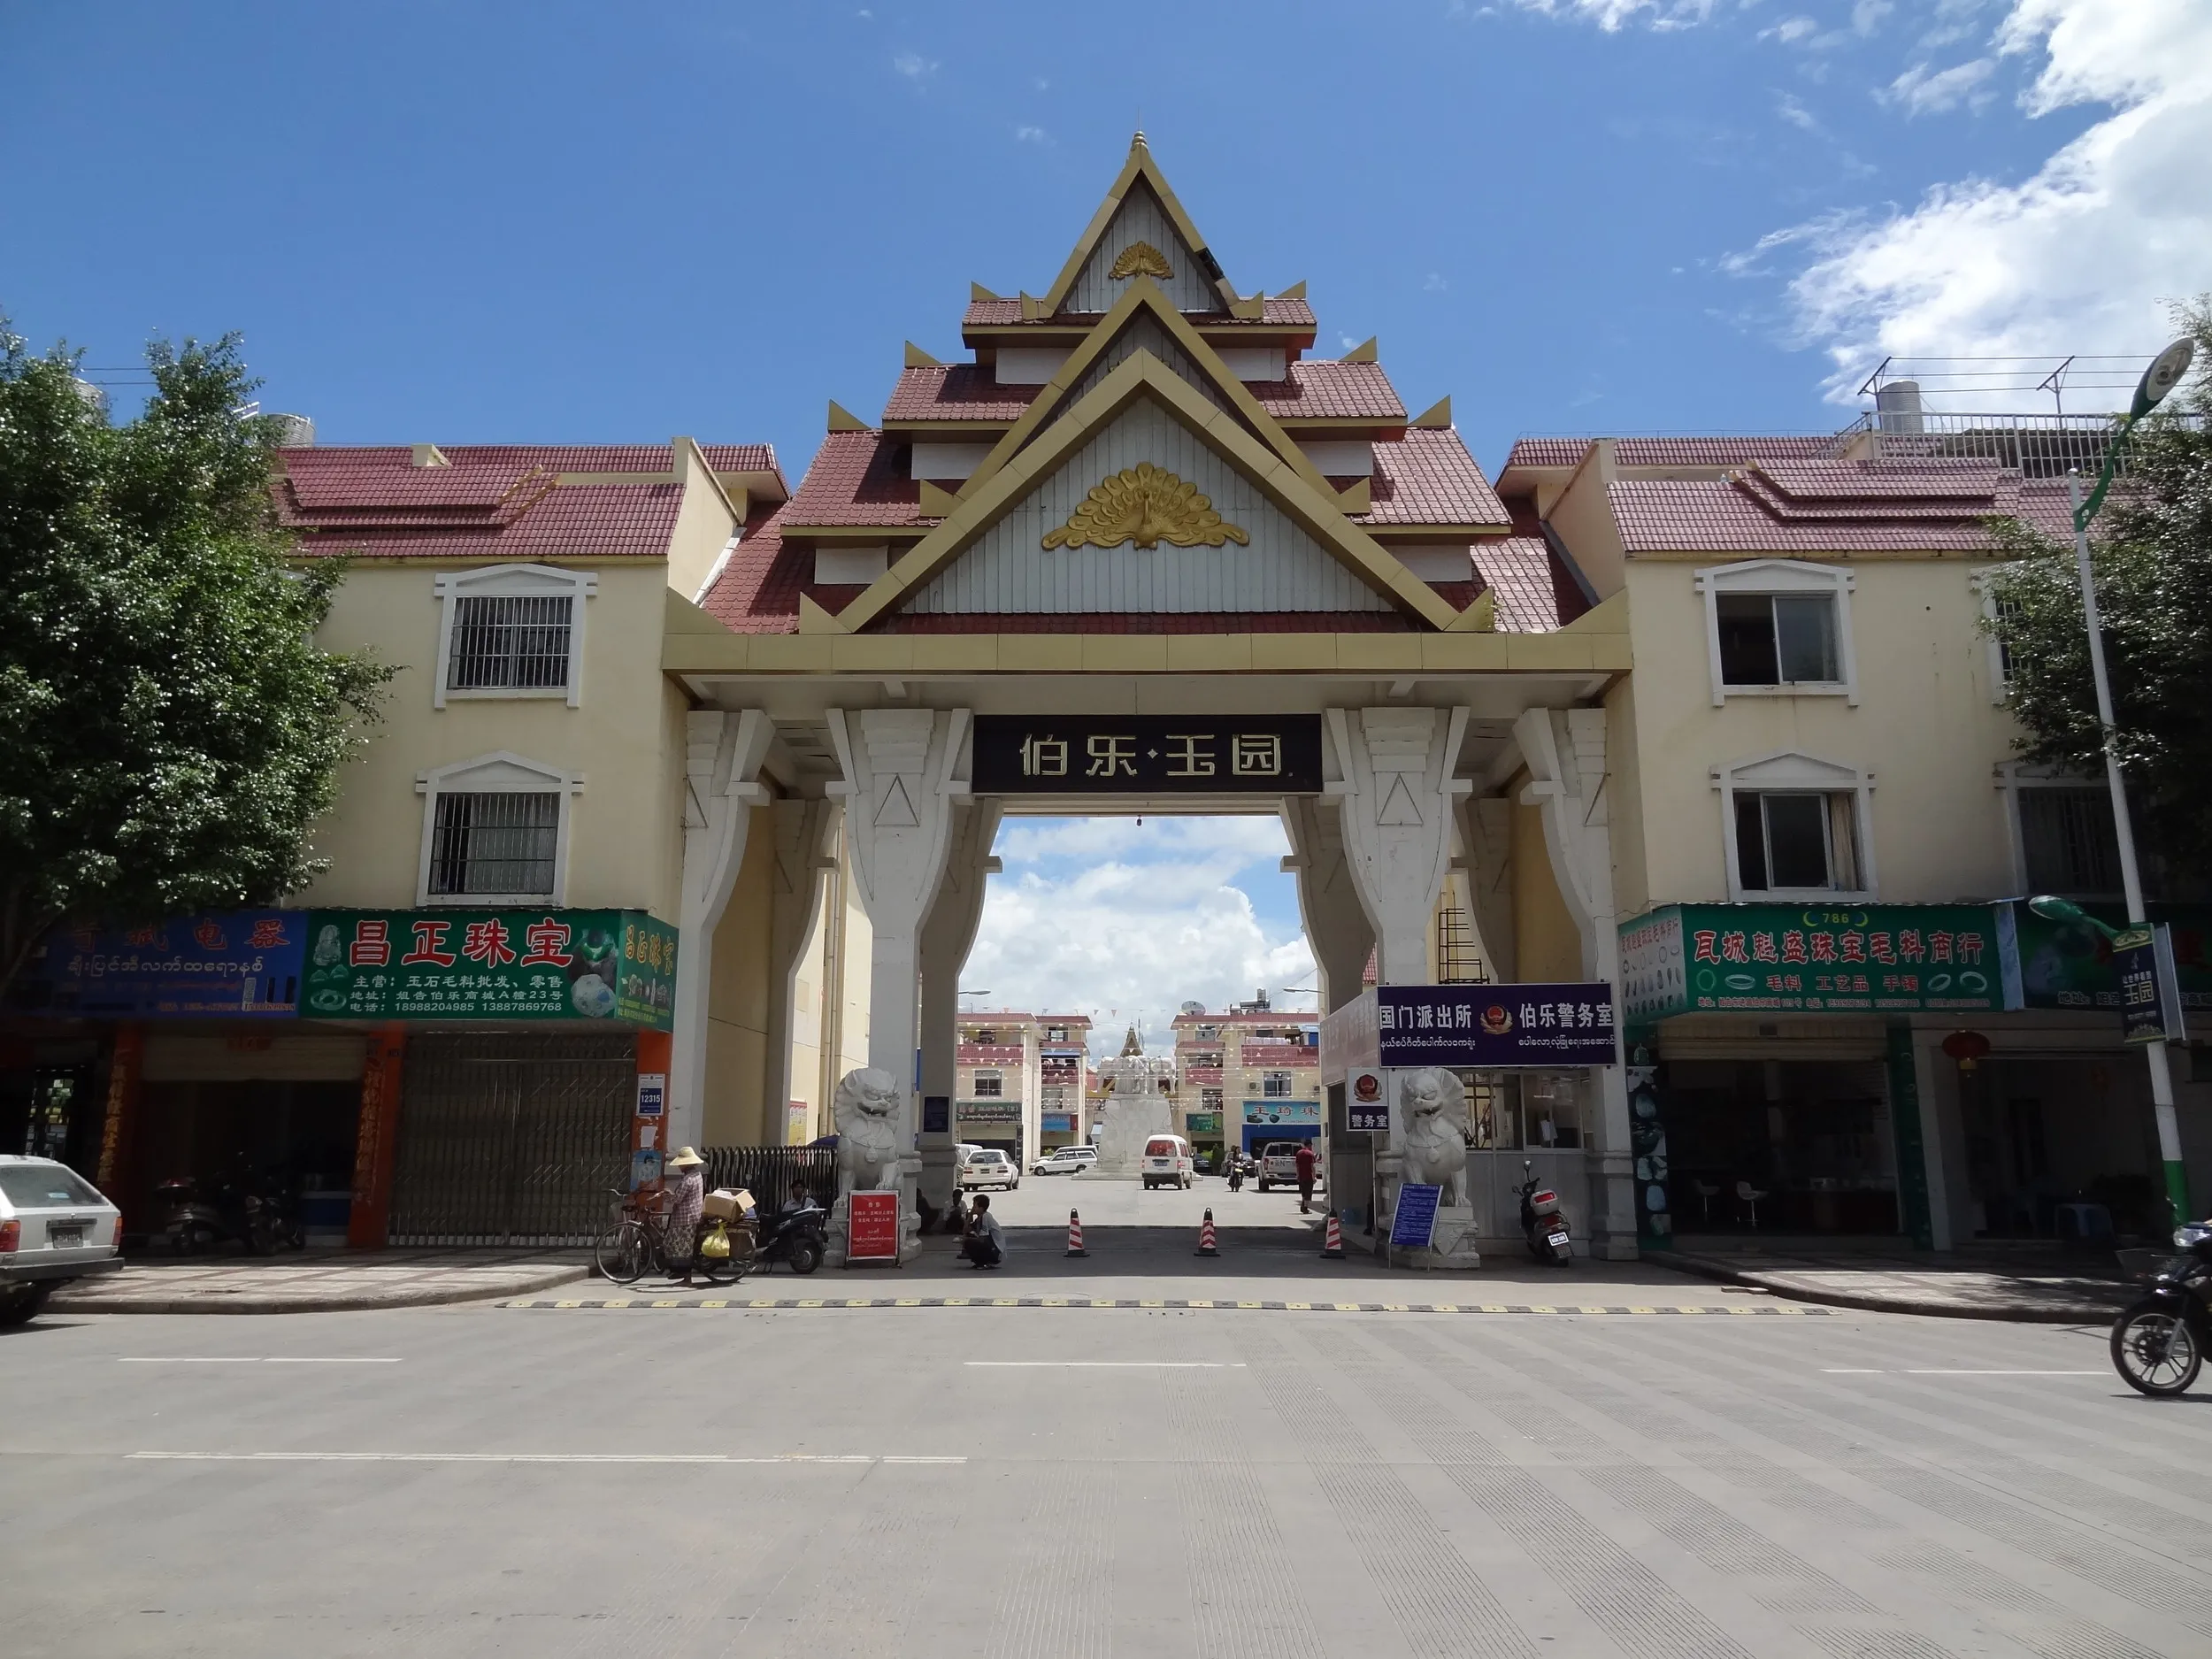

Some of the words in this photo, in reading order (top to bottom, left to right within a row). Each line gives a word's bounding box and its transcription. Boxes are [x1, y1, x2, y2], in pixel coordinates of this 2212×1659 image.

[1019, 733, 1280, 776] 伯乐·玉园
[1822, 912, 1849, 925] 786
[349, 918, 574, 970] 昌正珠宝
[1766, 975, 1802, 992] 毛料
[1816, 975, 1870, 993] 工艺品
[1379, 1004, 1472, 1030] 国门派出所
[1519, 1002, 1614, 1028] 伯乐警务室
[641, 1094, 661, 1103] 12315
[1351, 1115, 1389, 1127] 警务室
